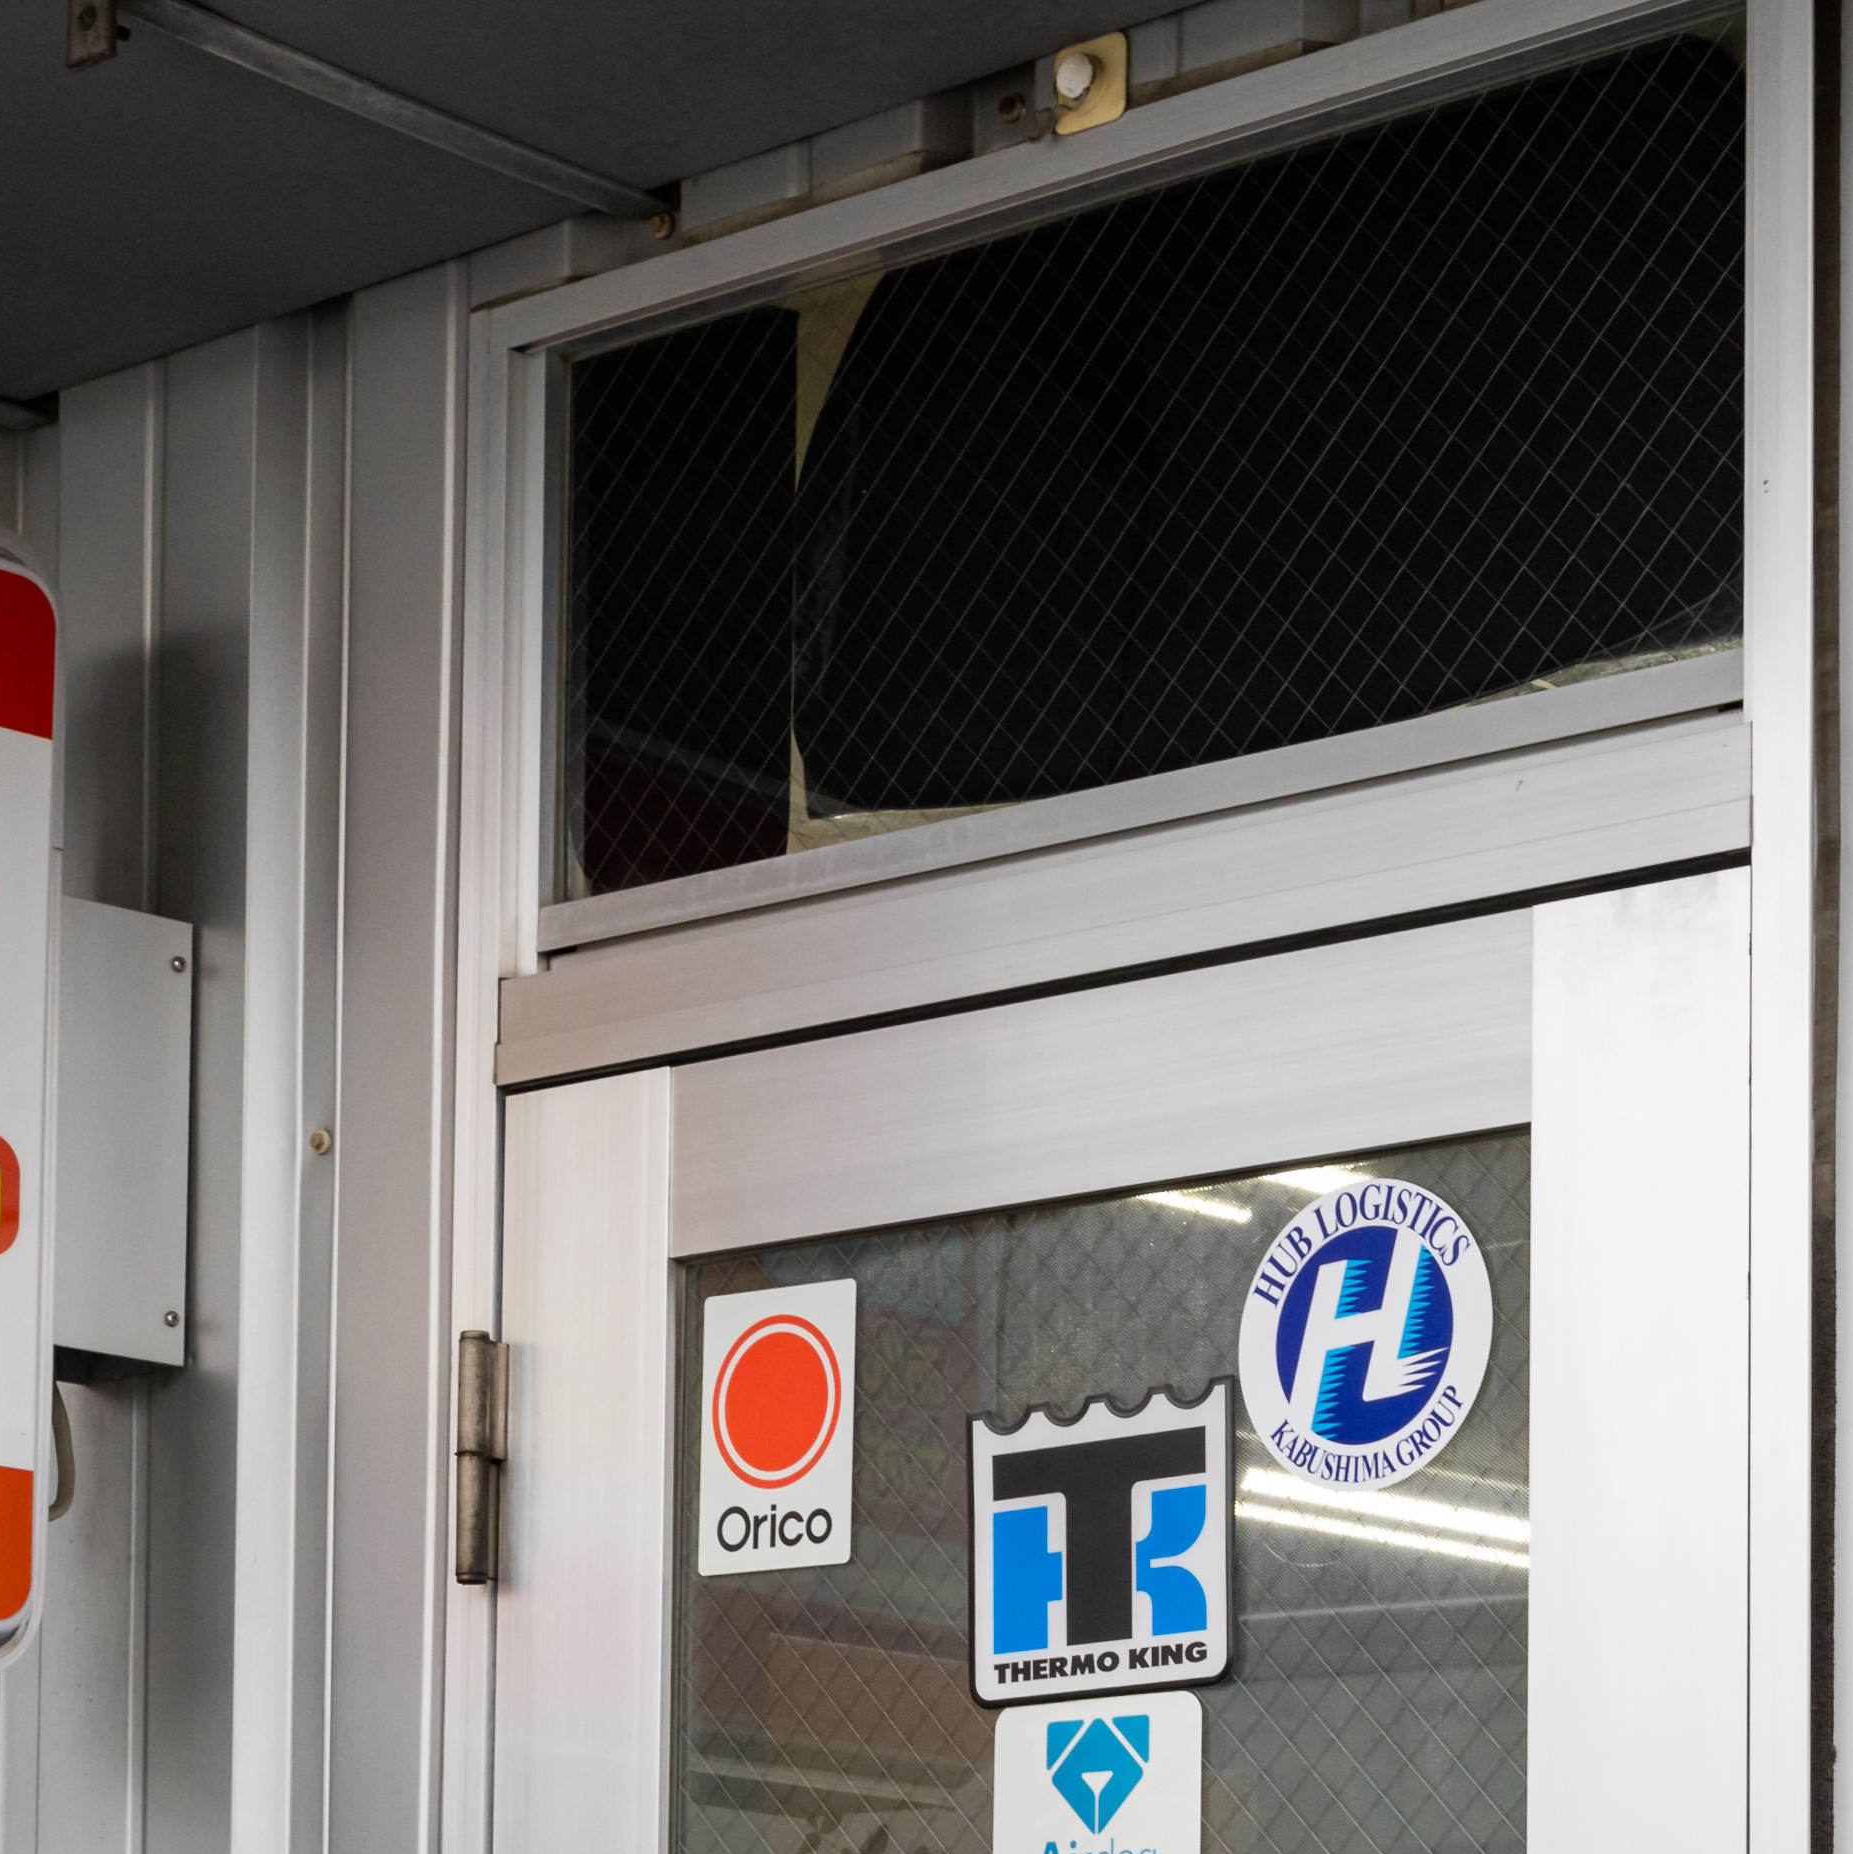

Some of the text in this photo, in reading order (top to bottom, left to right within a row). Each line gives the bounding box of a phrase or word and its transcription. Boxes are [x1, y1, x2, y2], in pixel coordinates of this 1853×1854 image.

[1253, 1183, 1472, 1308] HUB LOGISTICS
[1269, 1384, 1464, 1484] KABUSHIMA GROUP
[716, 1505, 833, 1554] Orico
[993, 1640, 1209, 1686] THERMO KING
